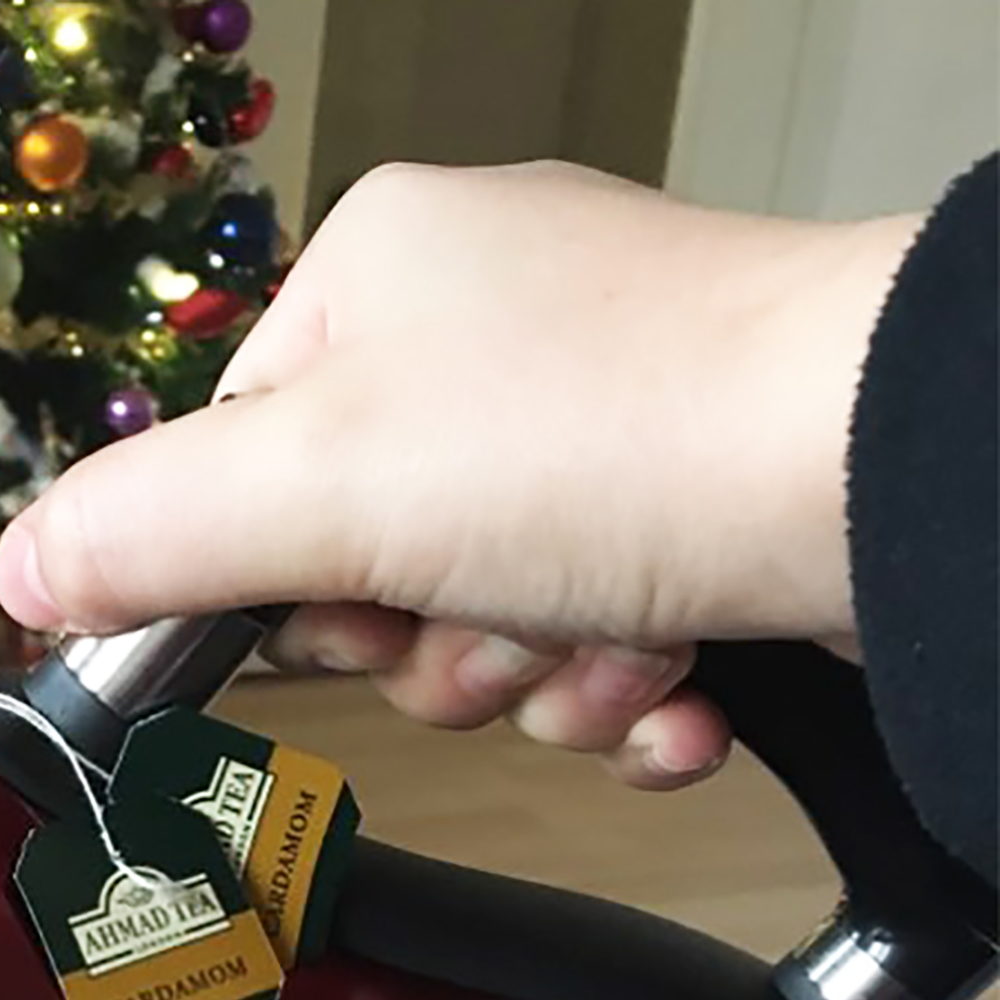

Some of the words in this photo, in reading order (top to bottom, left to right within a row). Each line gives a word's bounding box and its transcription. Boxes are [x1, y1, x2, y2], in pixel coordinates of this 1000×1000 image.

[217, 771, 255, 817] TEA
[84, 905, 171, 956] AHMAD
[168, 890, 217, 923] TEA
